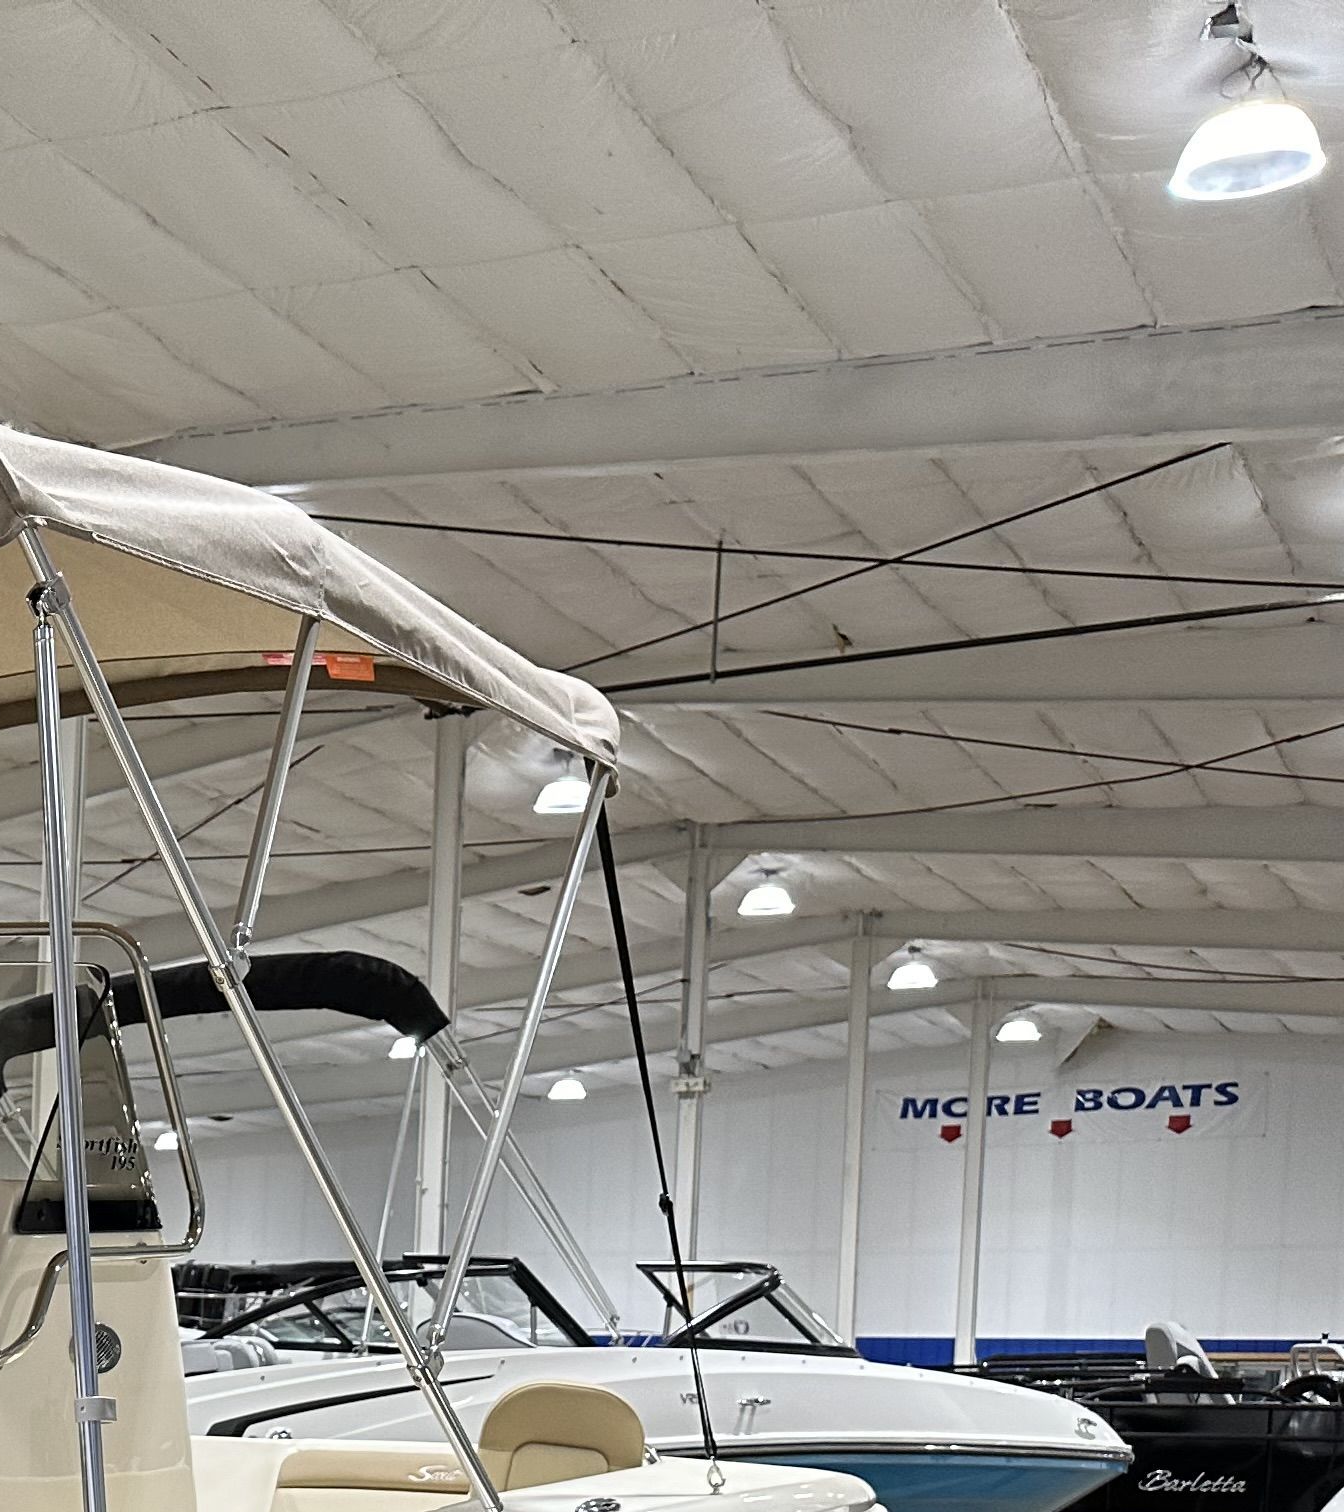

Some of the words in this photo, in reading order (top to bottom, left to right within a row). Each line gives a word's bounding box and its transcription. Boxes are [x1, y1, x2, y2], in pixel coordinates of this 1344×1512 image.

[899, 1091, 1041, 1119] MORE
[1074, 1081, 1239, 1112] BOATS
[1138, 1469, 1247, 1493] Barletta
